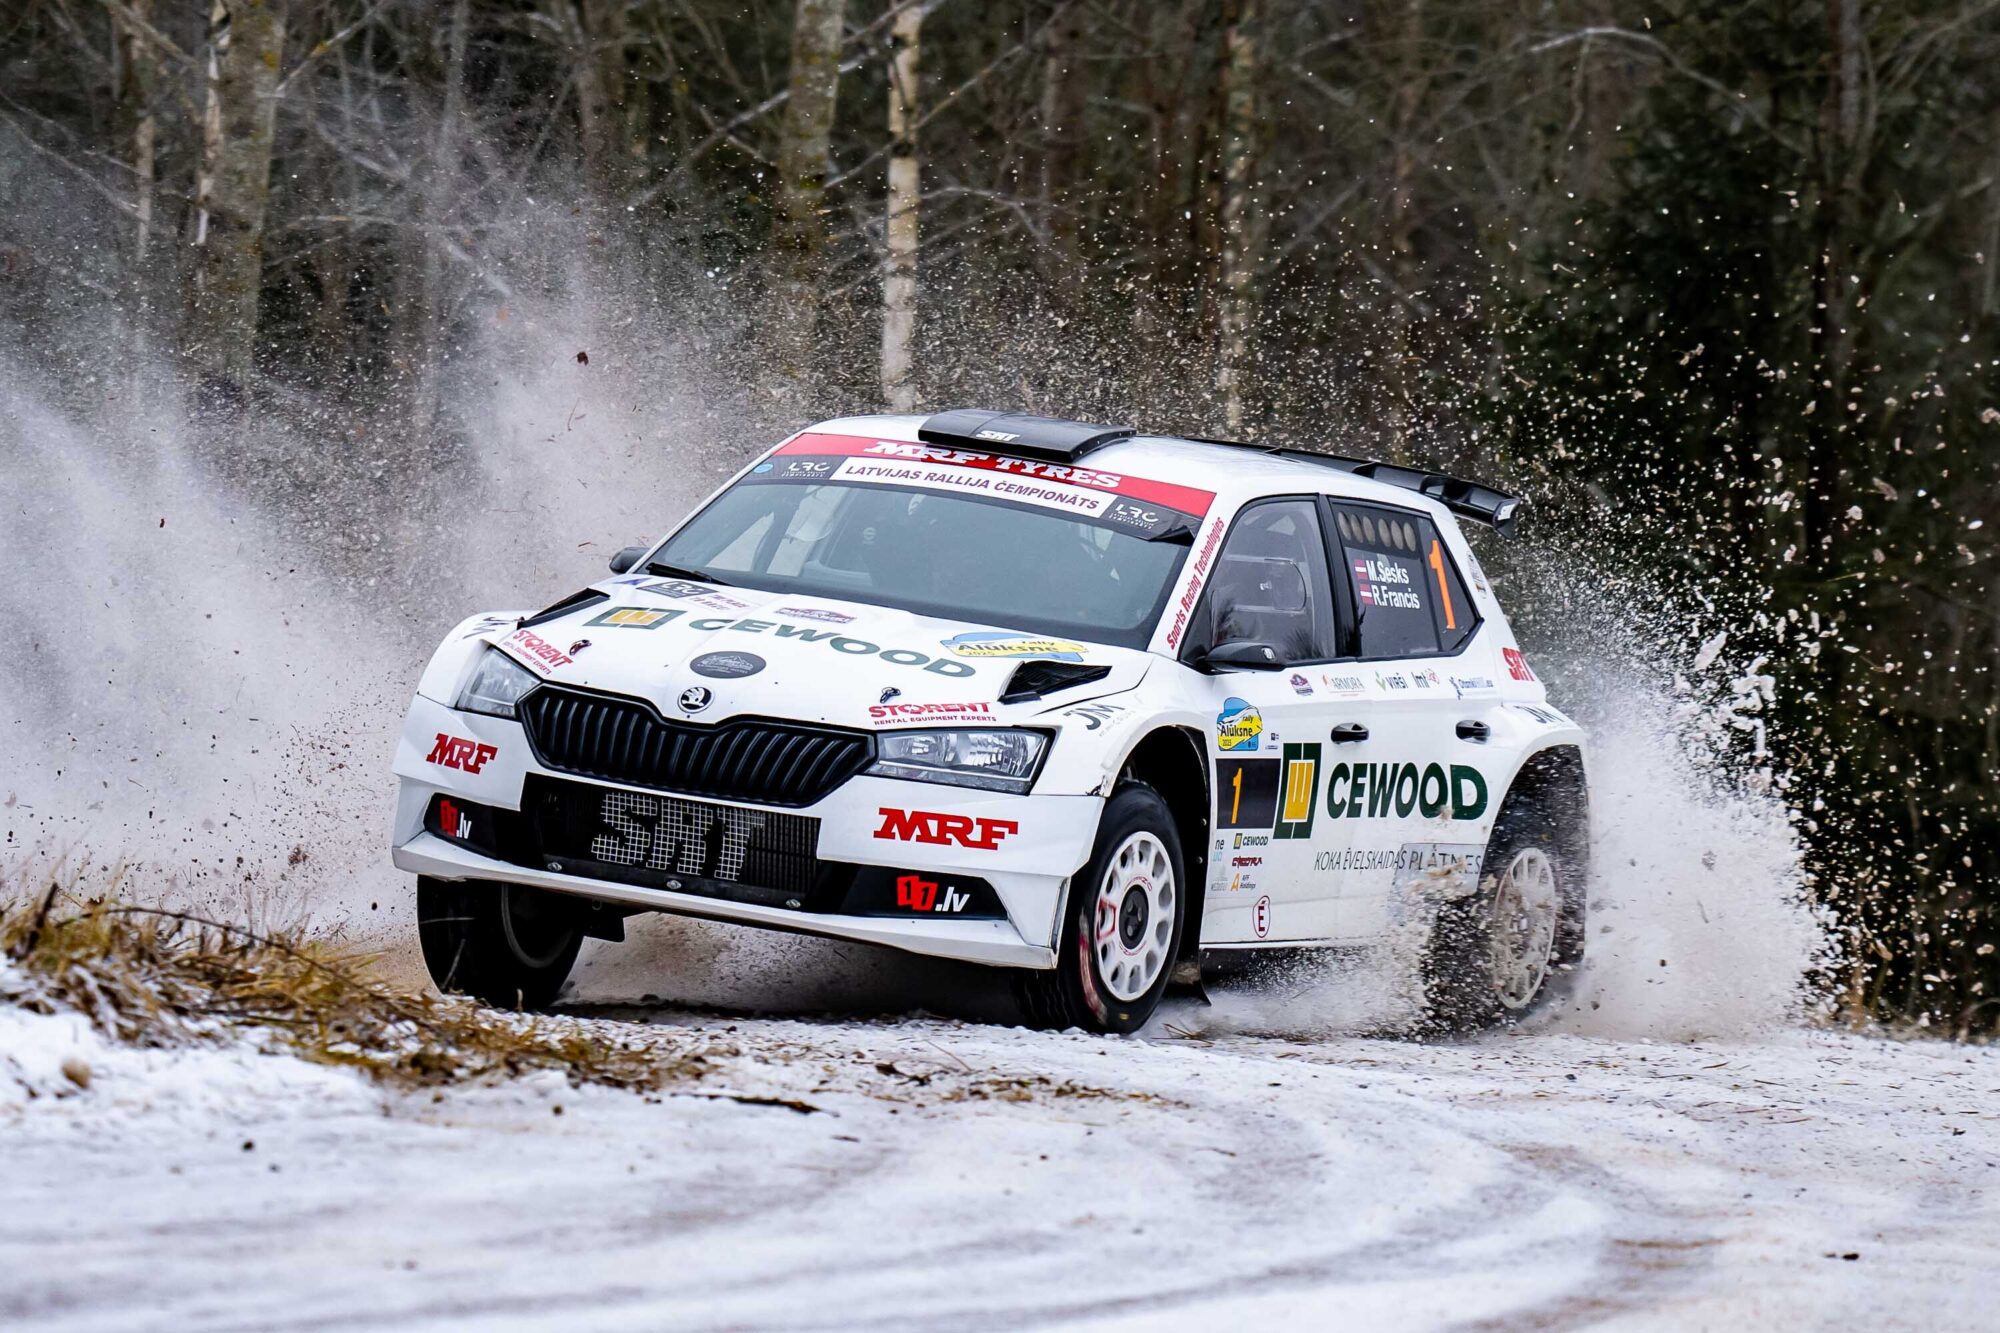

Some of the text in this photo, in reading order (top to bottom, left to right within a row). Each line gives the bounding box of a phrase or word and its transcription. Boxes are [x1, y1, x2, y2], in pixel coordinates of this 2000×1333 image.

[788, 461, 830, 471] LRC
[864, 441, 1121, 488] MRF TYRES
[845, 466, 921, 480] LATVIJAS
[924, 473, 990, 488] RALLIJA
[994, 480, 1100, 510] ČEMPIONĀTS
[1115, 503, 1159, 522] LRC
[1167, 517, 1225, 650] Sports Racing Technologies
[1366, 560, 1410, 584] M.Sesks
[1429, 540, 1456, 629] 1
[1371, 585, 1420, 609] R.Francis
[513, 630, 573, 667] STORENT
[689, 618, 976, 678] CEWOOD
[869, 702, 990, 717] STORENT
[426, 733, 498, 775] MRF
[1231, 768, 1242, 824] 1
[1327, 762, 1488, 820] CEWOOD
[873, 807, 1018, 850] MRF
[1243, 836, 1269, 846] CEWOOD
[1314, 851, 1341, 870] KOKA
